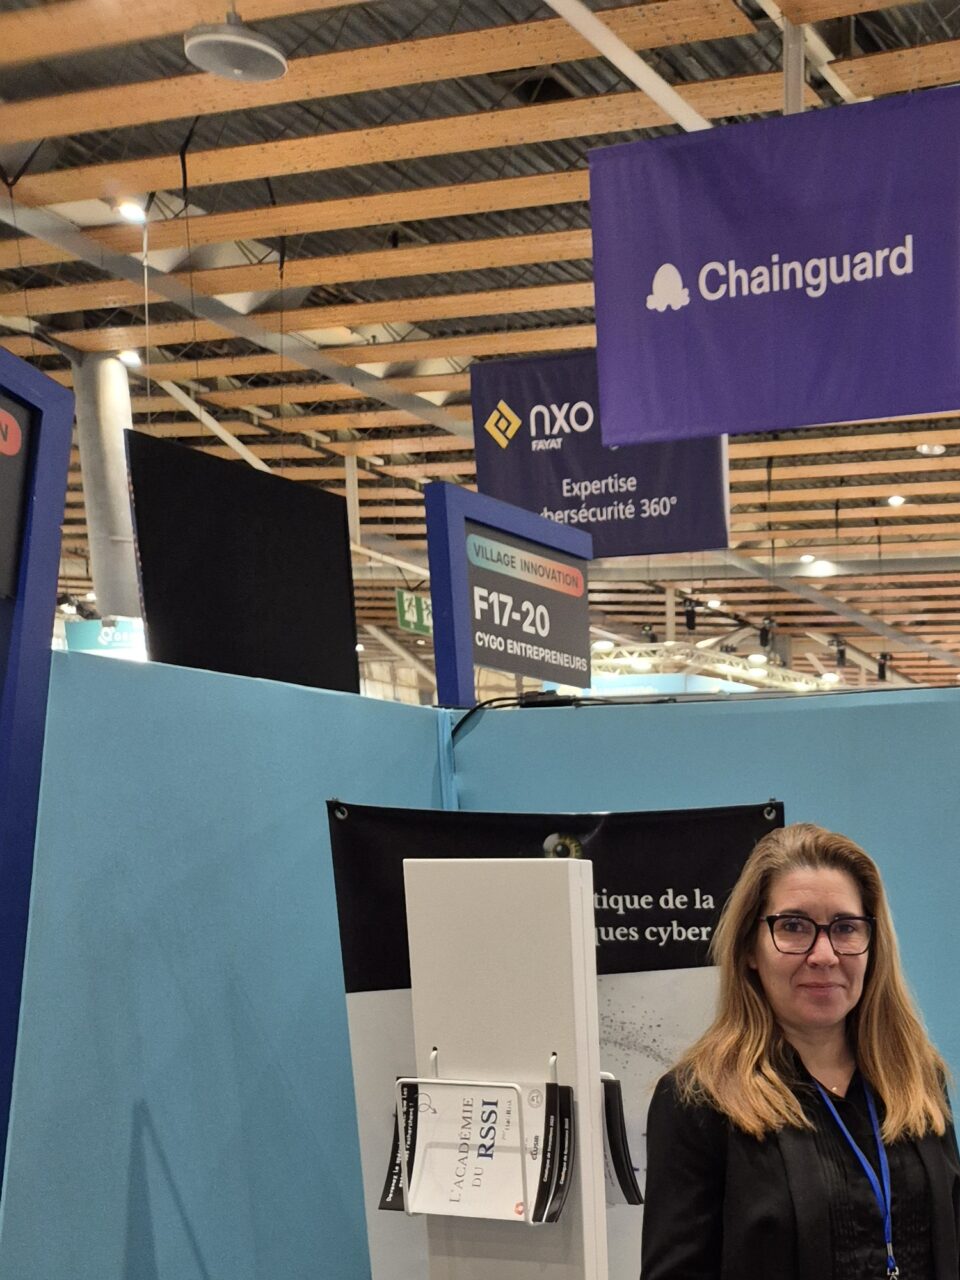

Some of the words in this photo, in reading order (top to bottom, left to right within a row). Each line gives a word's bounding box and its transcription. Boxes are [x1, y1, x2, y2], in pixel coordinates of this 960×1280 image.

[699, 234, 914, 301] Chainguard
[531, 437, 564, 452] FAYAT
[562, 474, 638, 500] Expertise
[640, 496, 678, 518] 360°
[472, 541, 517, 570] VILLAGE
[520, 556, 579, 589] INNOVATION
[473, 586, 551, 639] F17-20
[475, 630, 506, 652] CYGO
[506, 640, 588, 673] ENTREPRENEURS
[658, 887, 689, 910] de
[693, 887, 716, 910] la
[644, 919, 713, 947] cyber
[475, 1098, 499, 1161] RSSI
[449, 1097, 475, 1203] L'ACADÉMIE
[472, 1166, 484, 1189] DU
